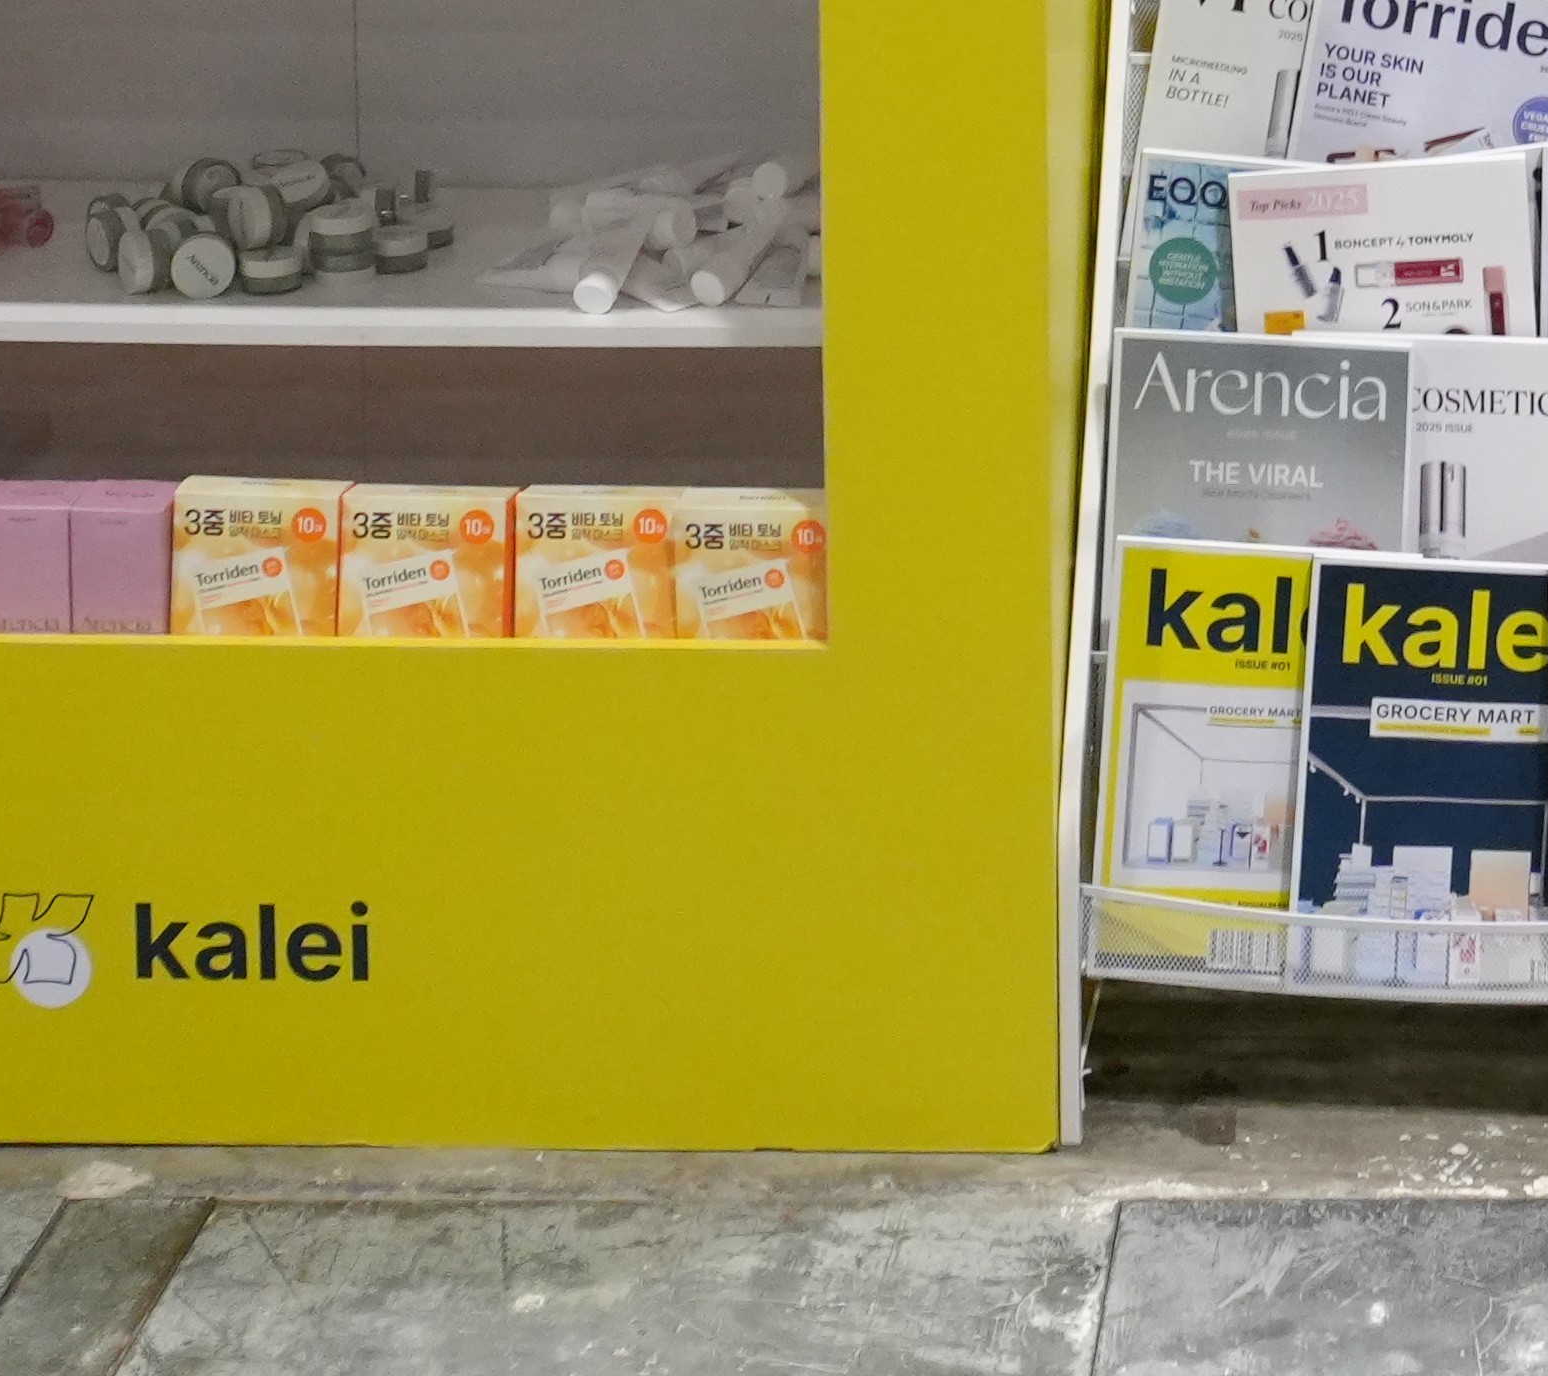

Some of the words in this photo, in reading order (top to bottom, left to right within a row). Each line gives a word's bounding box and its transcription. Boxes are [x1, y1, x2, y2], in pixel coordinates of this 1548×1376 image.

[1324, 43, 1376, 66] YOUR
[1381, 53, 1425, 75] SKIN
[1168, 68, 1186, 84] IN
[1189, 71, 1201, 85] A
[1319, 63, 1336, 78] IS
[1341, 66, 1382, 87] OUR
[1165, 85, 1230, 110] BOTTLE!
[1316, 82, 1391, 108] PLANET
[1305, 189, 1361, 214] 2025
[1314, 230, 1328, 262] 1
[1406, 232, 1475, 247] TONYMOLY
[1380, 297, 1402, 330] 2
[1405, 298, 1473, 314] SON&PARK
[1133, 350, 1388, 422] Arencia
[1444, 422, 1474, 434] ISSUE
[1189, 459, 1240, 485] THE
[1247, 462, 1325, 489] VIRAL
[184, 508, 226, 537] 3중
[229, 509, 253, 525] 비타
[352, 510, 394, 539] 3중
[397, 511, 422, 527] 비타
[527, 512, 567, 540] 3중
[571, 513, 596, 527] 비타
[728, 523, 754, 537] 비타
[684, 522, 725, 550] 3중
[194, 561, 260, 587] Torriden
[363, 564, 428, 592] Torriden
[538, 564, 602, 591] Torriden
[698, 575, 763, 600] Torriden
[1145, 567, 1308, 655] kal
[1234, 659, 1268, 670] ISSUE
[1270, 660, 1291, 672] #01
[1431, 672, 1465, 685] ISSUE
[1209, 705, 1266, 718] GROCERY
[1267, 707, 1302, 720] MART
[1375, 702, 1471, 724] GROCERY
[1477, 704, 1536, 726] MART
[134, 899, 370, 983] kalei
